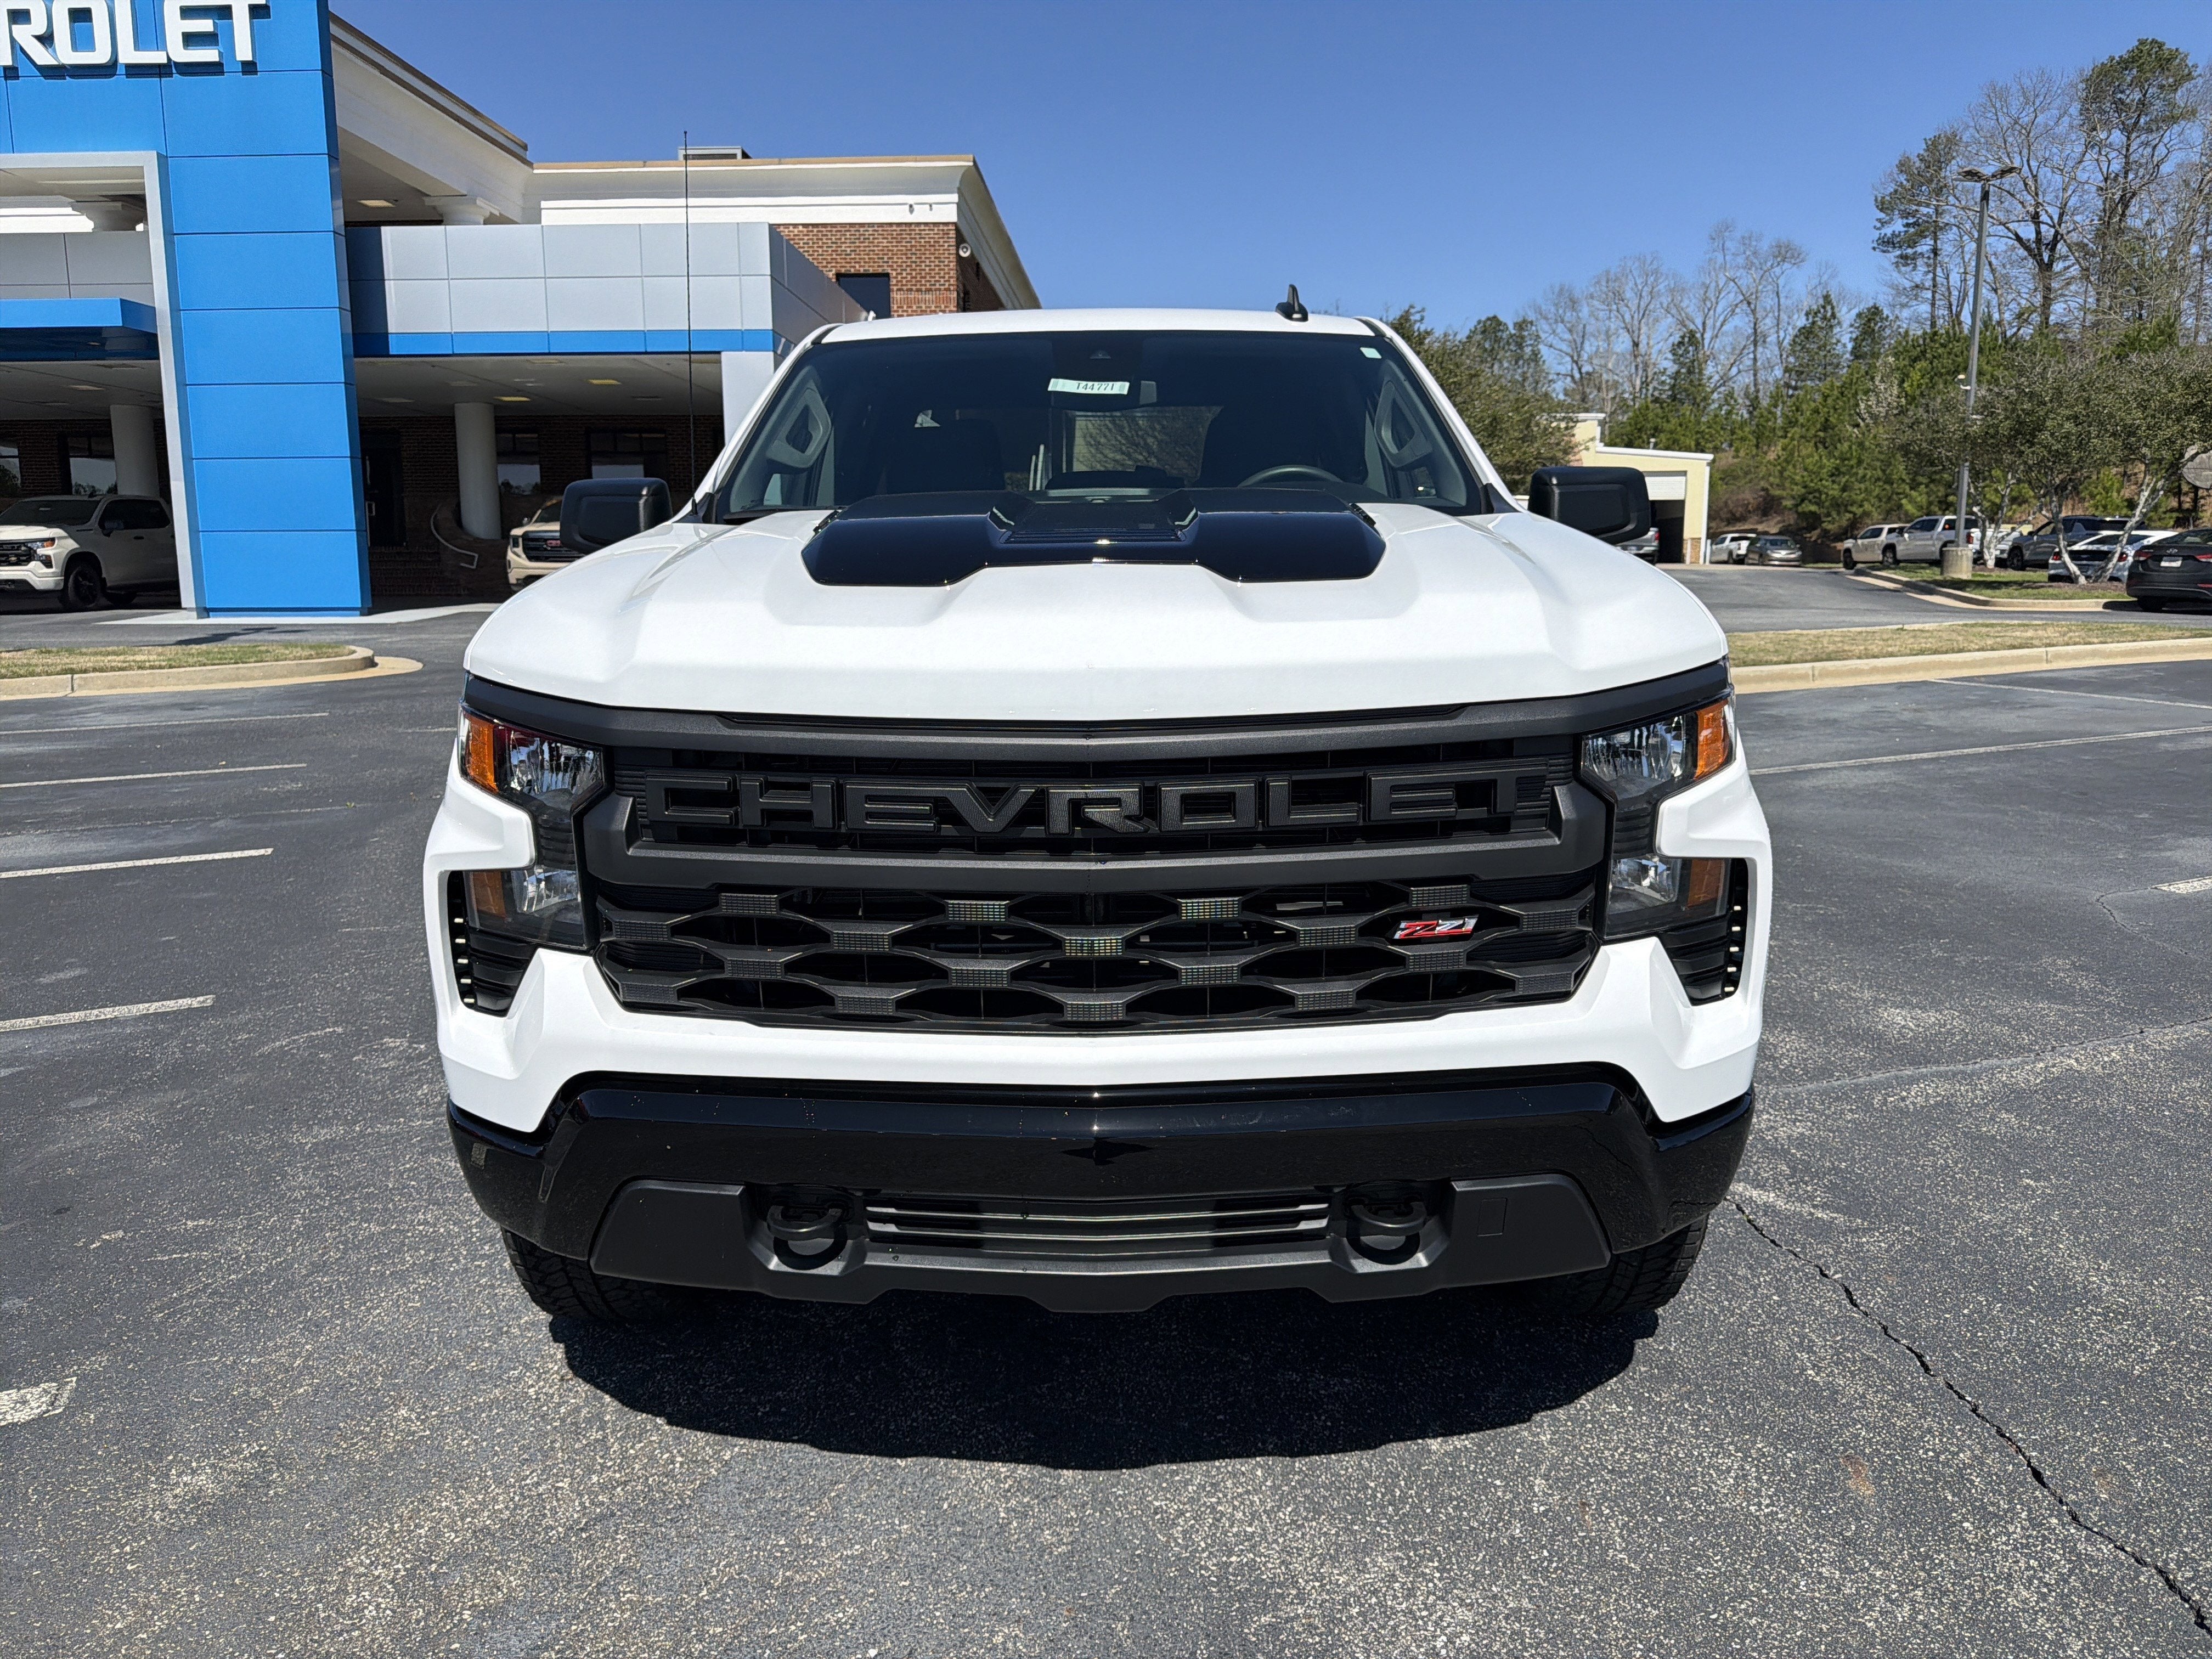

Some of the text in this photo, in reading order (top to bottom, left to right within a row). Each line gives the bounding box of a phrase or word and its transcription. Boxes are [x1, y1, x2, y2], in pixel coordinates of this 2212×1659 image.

[0, 0, 266, 65] ROLET
[1076, 382, 1115, 391] T44771
[645, 763, 1548, 837] CHEVROLET
[1394, 915, 1479, 939] Z71
